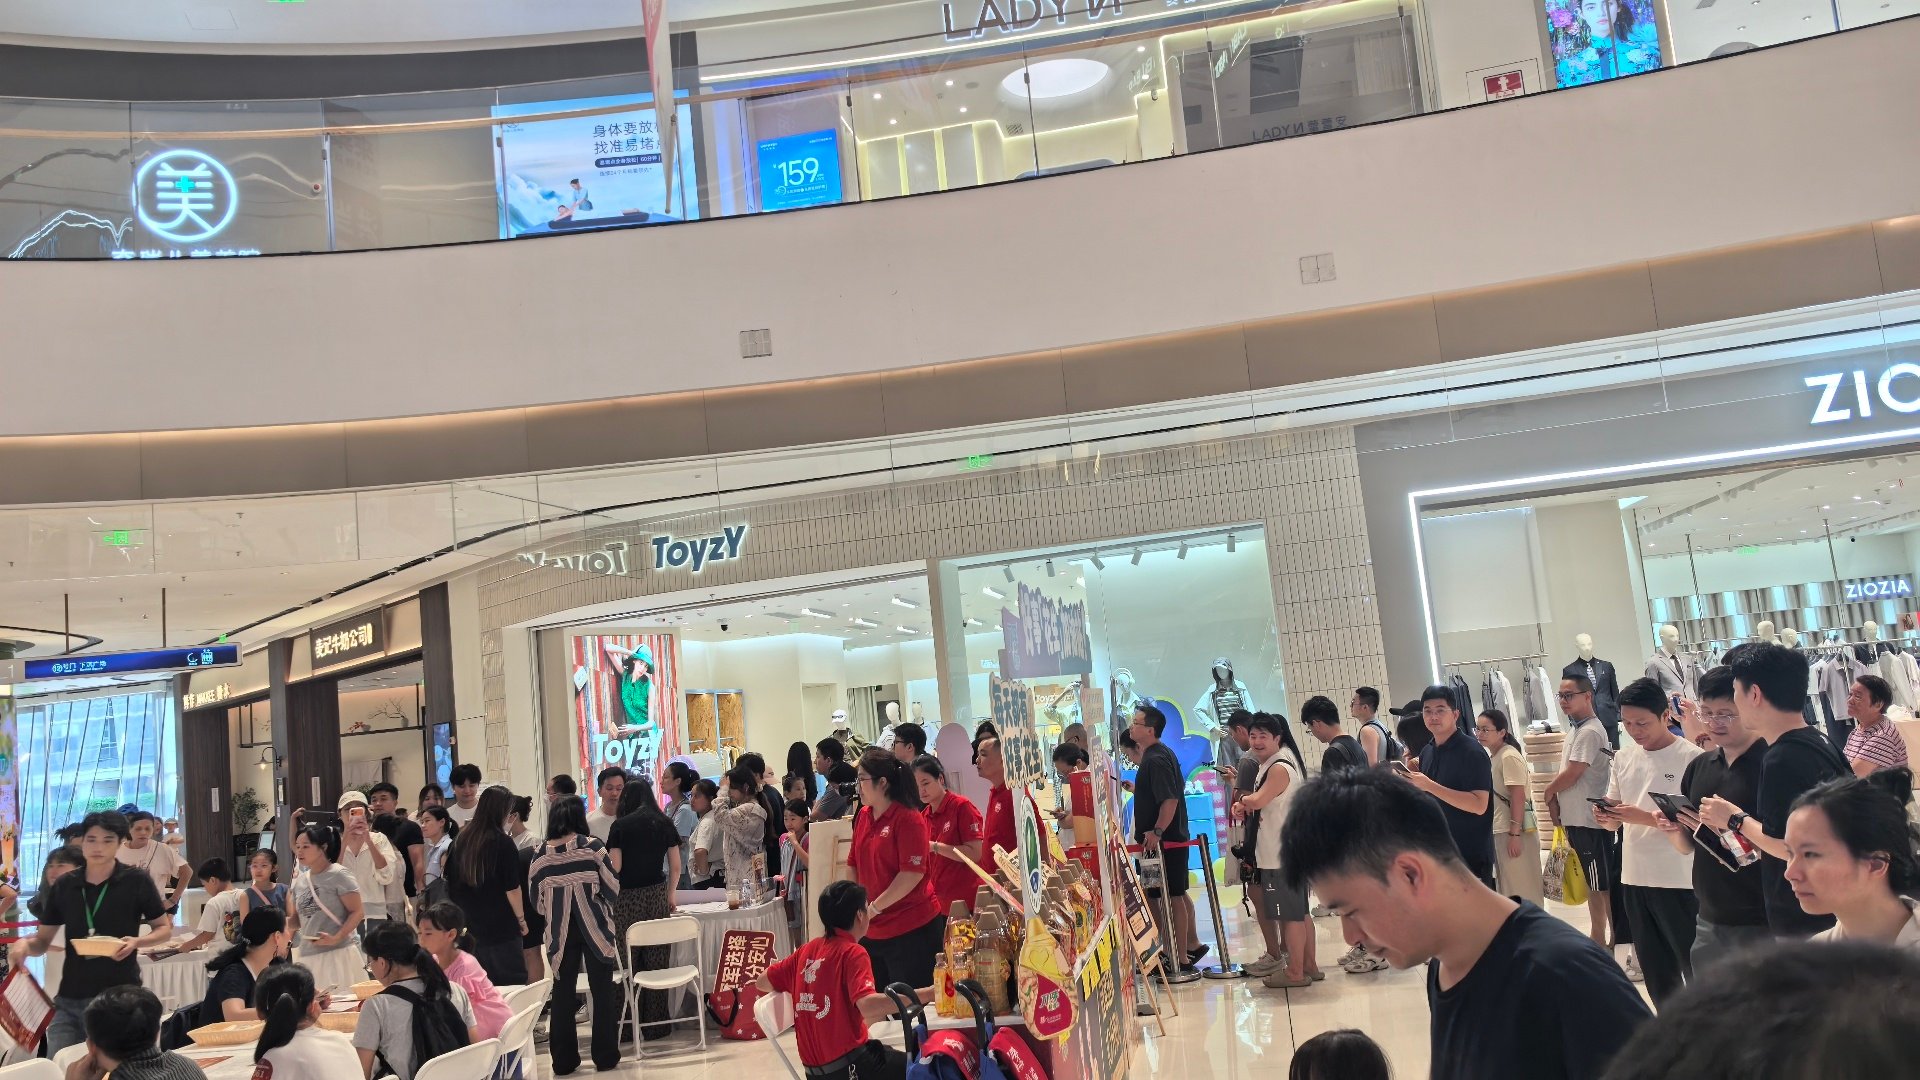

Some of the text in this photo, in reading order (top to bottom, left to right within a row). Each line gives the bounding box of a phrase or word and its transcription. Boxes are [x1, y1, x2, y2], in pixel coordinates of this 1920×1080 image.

[593, 120, 659, 138] 身体要放
[594, 137, 660, 154] 找准易堵
[651, 524, 748, 573] ToyzY
[1845, 579, 1911, 599] ZIOZIA
[992, 683, 1028, 735] 每天都有
[744, 936, 770, 987] 分安心
